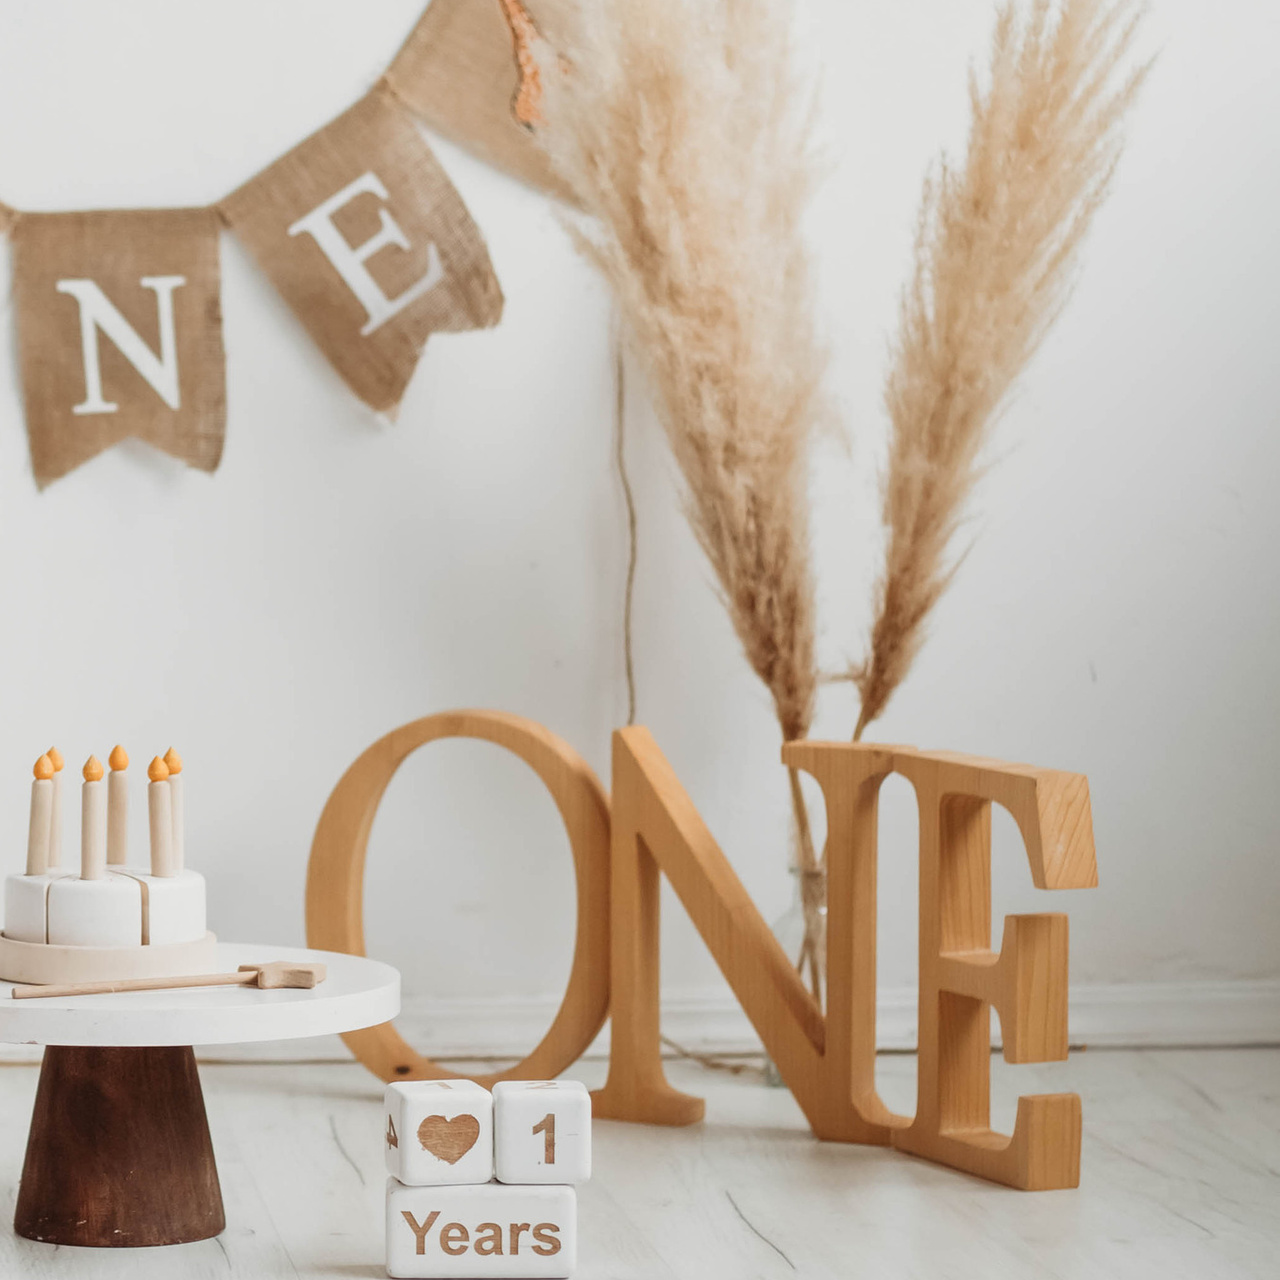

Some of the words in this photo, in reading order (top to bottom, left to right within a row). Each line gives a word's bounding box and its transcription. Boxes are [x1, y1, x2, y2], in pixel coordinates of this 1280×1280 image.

[305, 708, 1098, 1190] ONE
[532, 1113, 556, 1164] 1
[401, 1210, 562, 1256] Years
